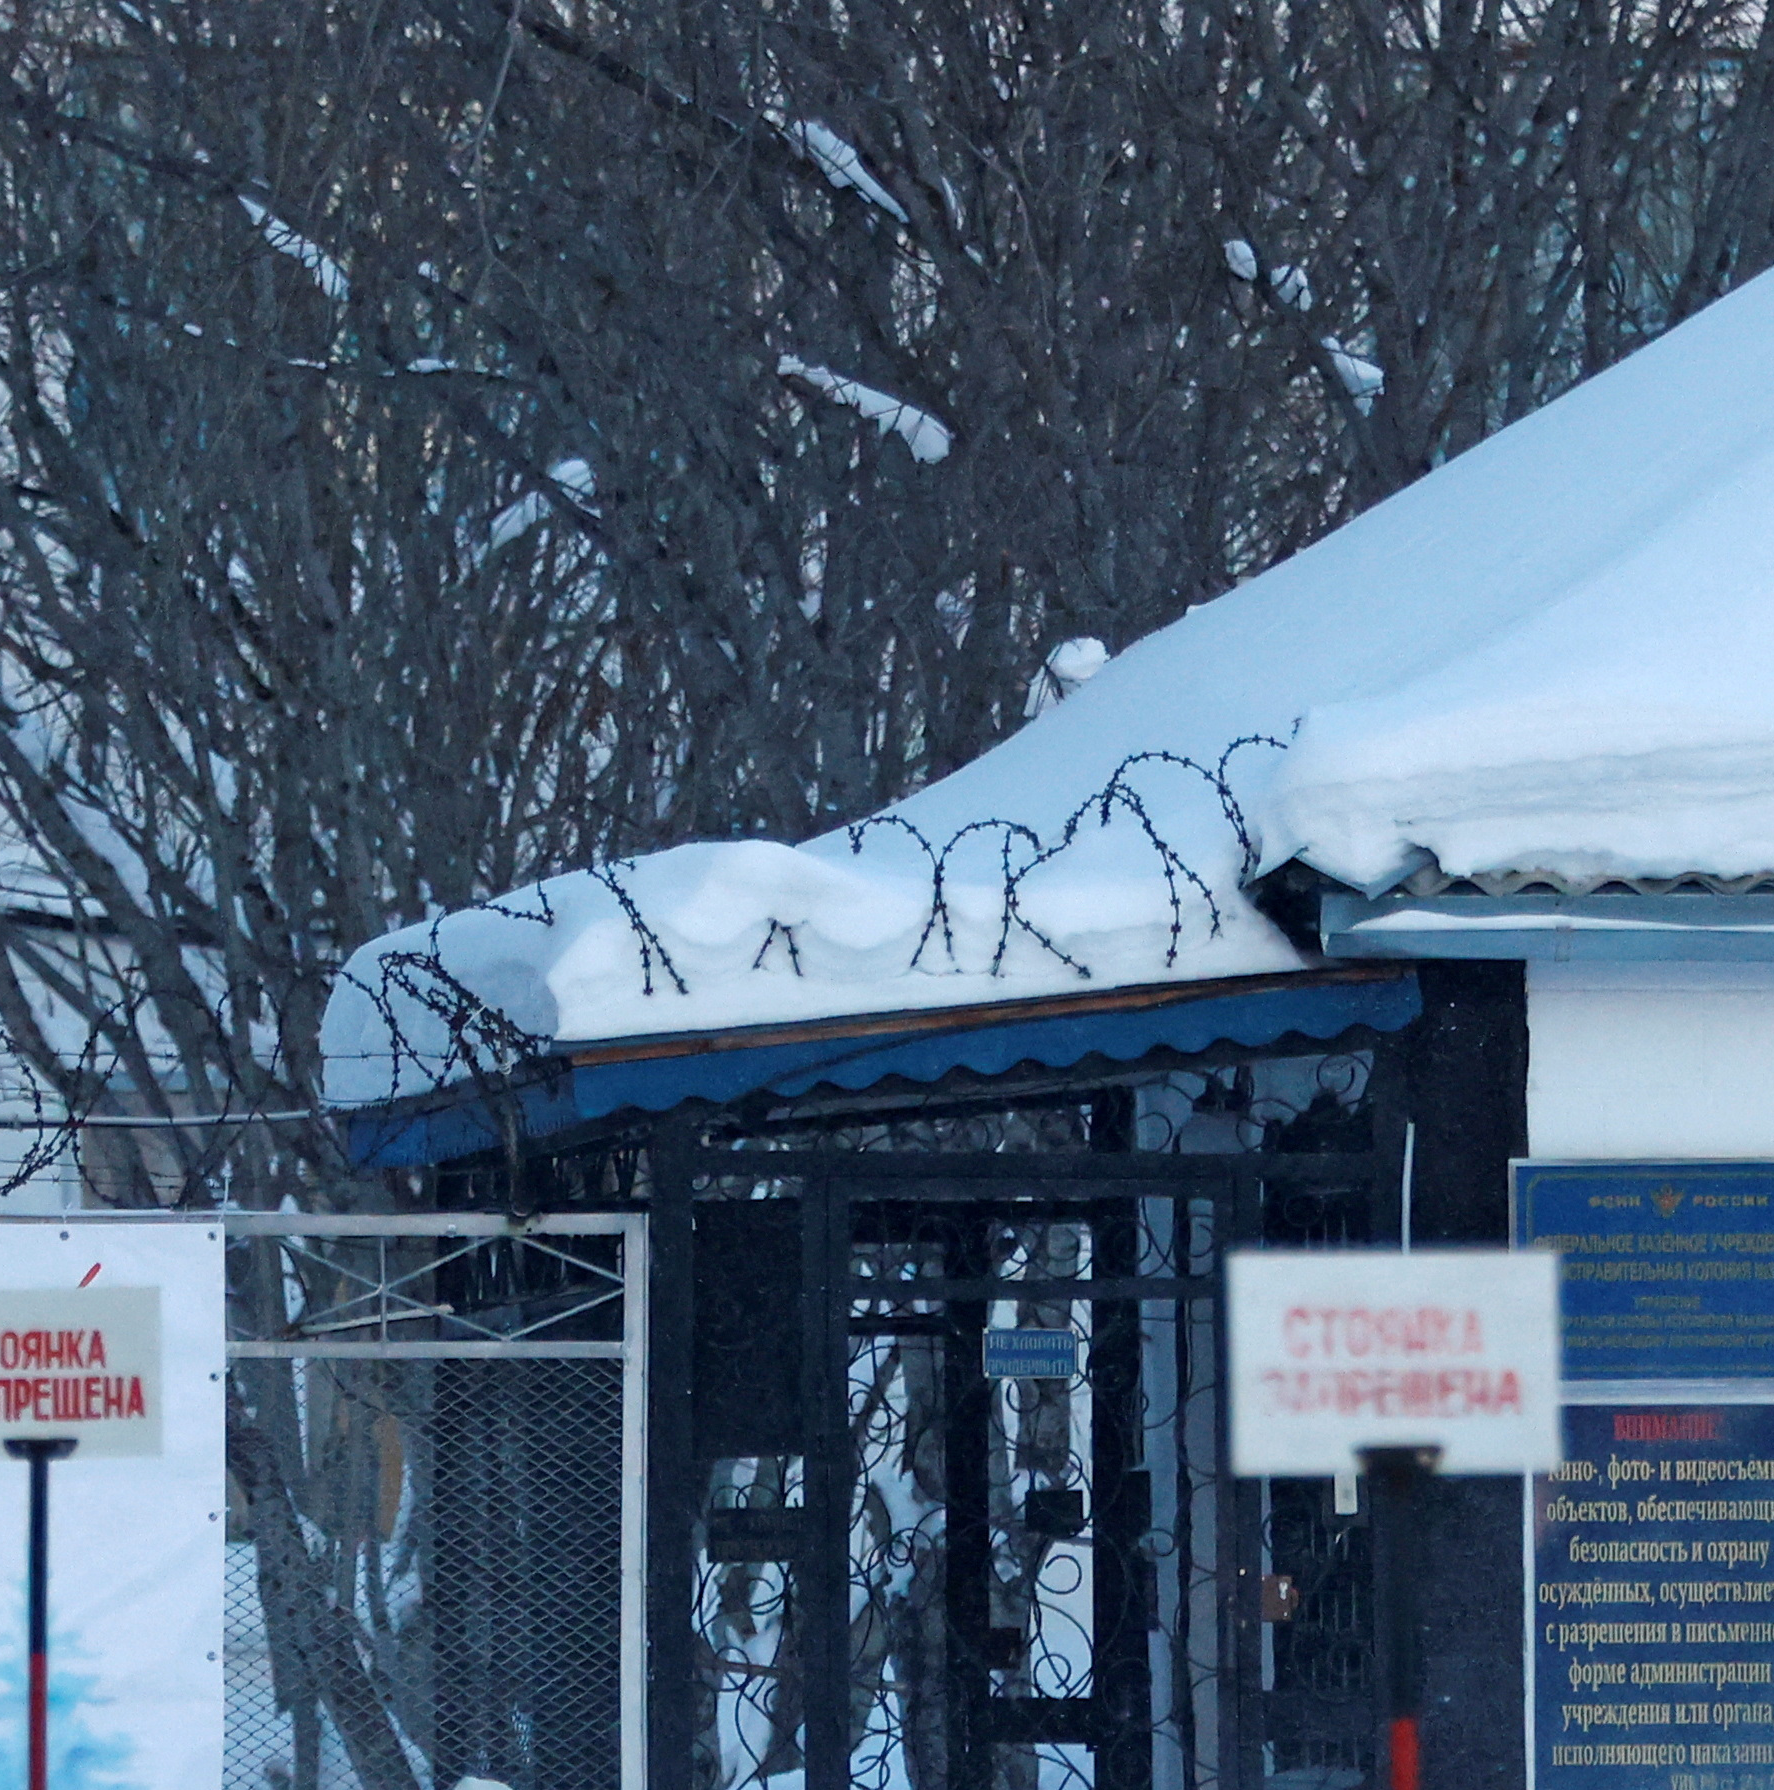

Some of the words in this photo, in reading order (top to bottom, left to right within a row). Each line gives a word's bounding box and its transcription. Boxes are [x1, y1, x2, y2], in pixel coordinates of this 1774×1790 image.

[1607, 1453, 1656, 1490] фото-
[1660, 1461, 1671, 1481] и
[1547, 1495, 1633, 1525] объектов,
[1569, 1535, 1688, 1563] безопасность
[1692, 1541, 1703, 1562] и
[1707, 1541, 1770, 1569] охрану
[1546, 1623, 1555, 1643] с
[1559, 1622, 1667, 1651] разрешения
[1671, 1623, 1682, 1643] в
[1568, 1657, 1626, 1692] форме
[1630, 1662, 1772, 1690] администрации
[1561, 1703, 1671, 1732] учреждения
[1674, 1703, 1709, 1725] или
[1552, 1744, 1686, 1769] исполняющего
